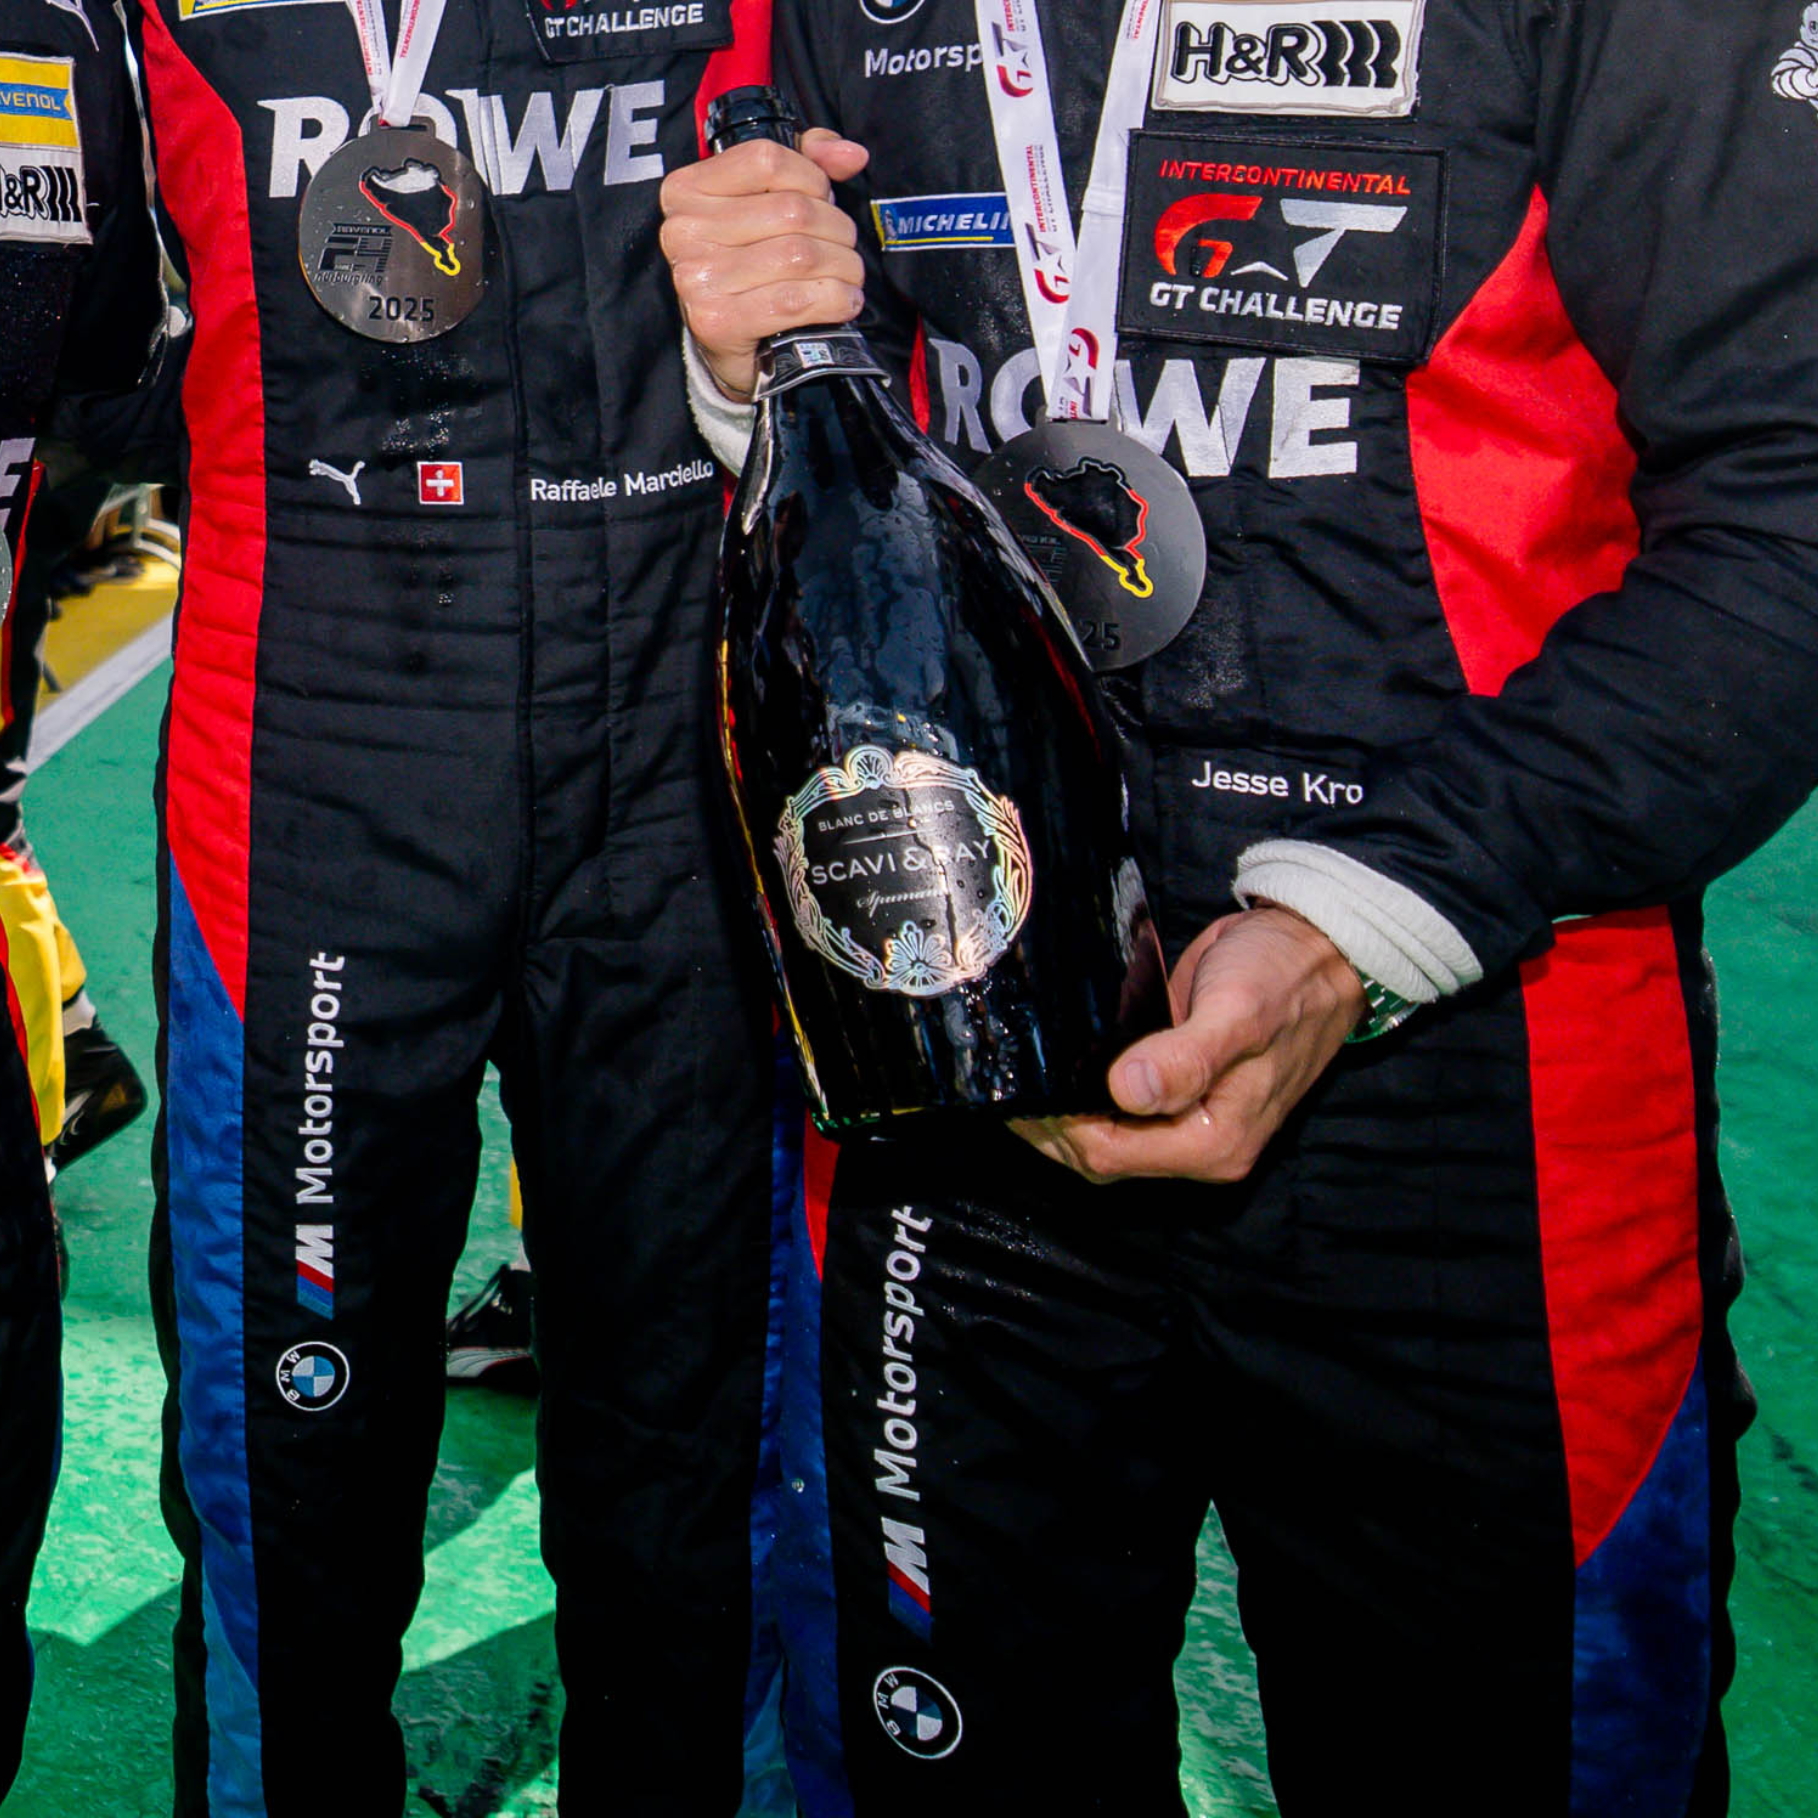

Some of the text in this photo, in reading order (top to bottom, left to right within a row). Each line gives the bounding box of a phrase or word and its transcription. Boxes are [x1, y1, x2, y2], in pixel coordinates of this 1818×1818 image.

[565, 2, 703, 37] CHALLENGE
[864, 41, 984, 78] Motorsp
[1025, 144, 1047, 234] INTERCONTINENTAL
[1159, 160, 1411, 195] INTERCONTINENTAL
[368, 295, 435, 322] 2025
[1149, 281, 1403, 330] GT CHALLENGE
[530, 458, 715, 503] Raffaele Marciello
[1191, 760, 1290, 798] Jesse
[818, 799, 956, 832] BLANC DE BLANCS
[811, 852, 897, 886] SCAVI
[901, 846, 928, 872] &
[295, 952, 345, 1205] Motorsport
[874, 1204, 933, 1502] Motorsport
